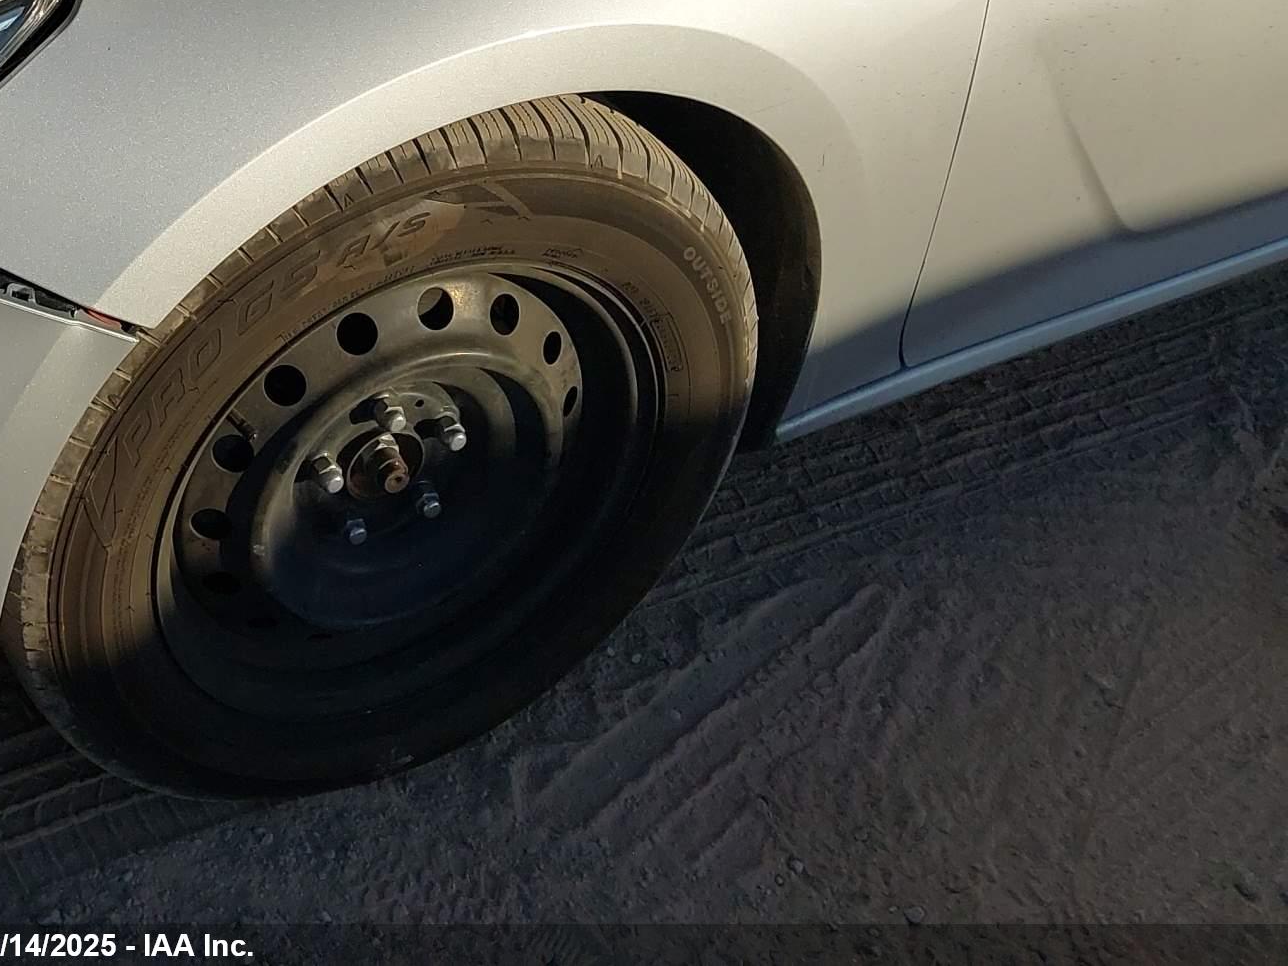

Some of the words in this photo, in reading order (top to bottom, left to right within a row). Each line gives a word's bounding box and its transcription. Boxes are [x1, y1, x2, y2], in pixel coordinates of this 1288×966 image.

[121, 327, 223, 469] PRO
[336, 211, 431, 268] A/S
[683, 246, 732, 324] OUTSIDE
